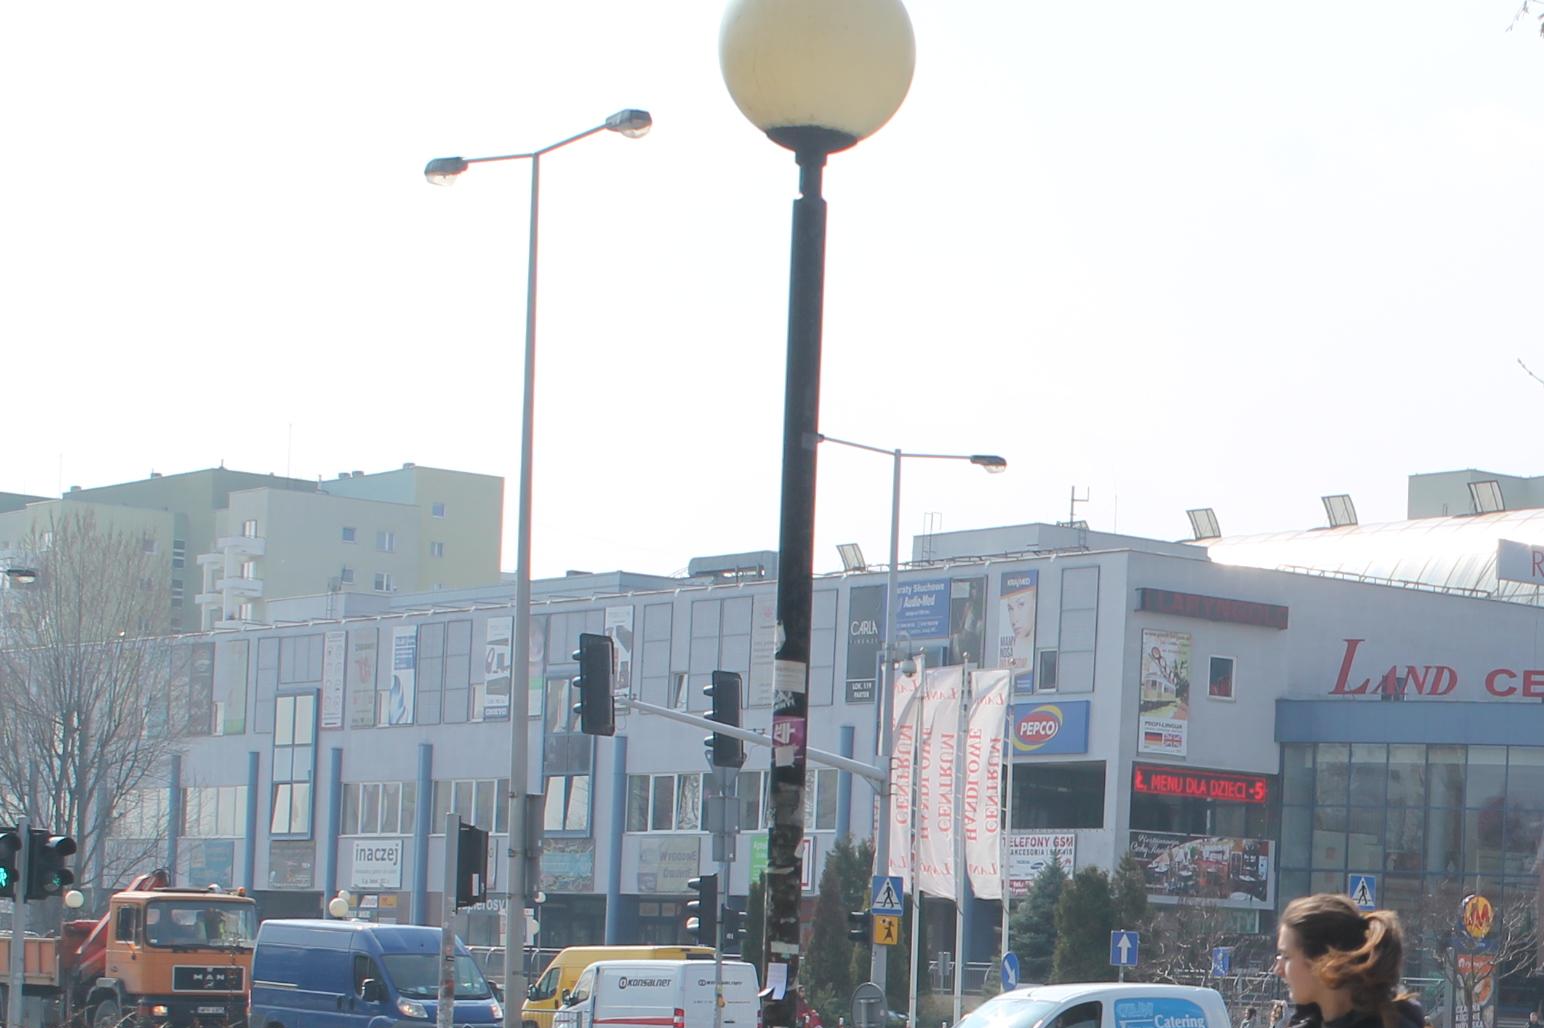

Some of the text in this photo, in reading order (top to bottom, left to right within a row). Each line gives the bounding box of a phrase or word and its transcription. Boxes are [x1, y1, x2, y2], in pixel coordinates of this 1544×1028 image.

[850, 621, 878, 636] CARLA
[1328, 639, 1458, 696] LAND
[1020, 720, 1056, 735] PEPCO
[1151, 774, 1183, 793] MENU
[1186, 779, 1206, 795] DLA
[1210, 780, 1246, 799] DZIECI
[1053, 836, 1074, 848] GSM
[355, 843, 399, 866] inaczej
